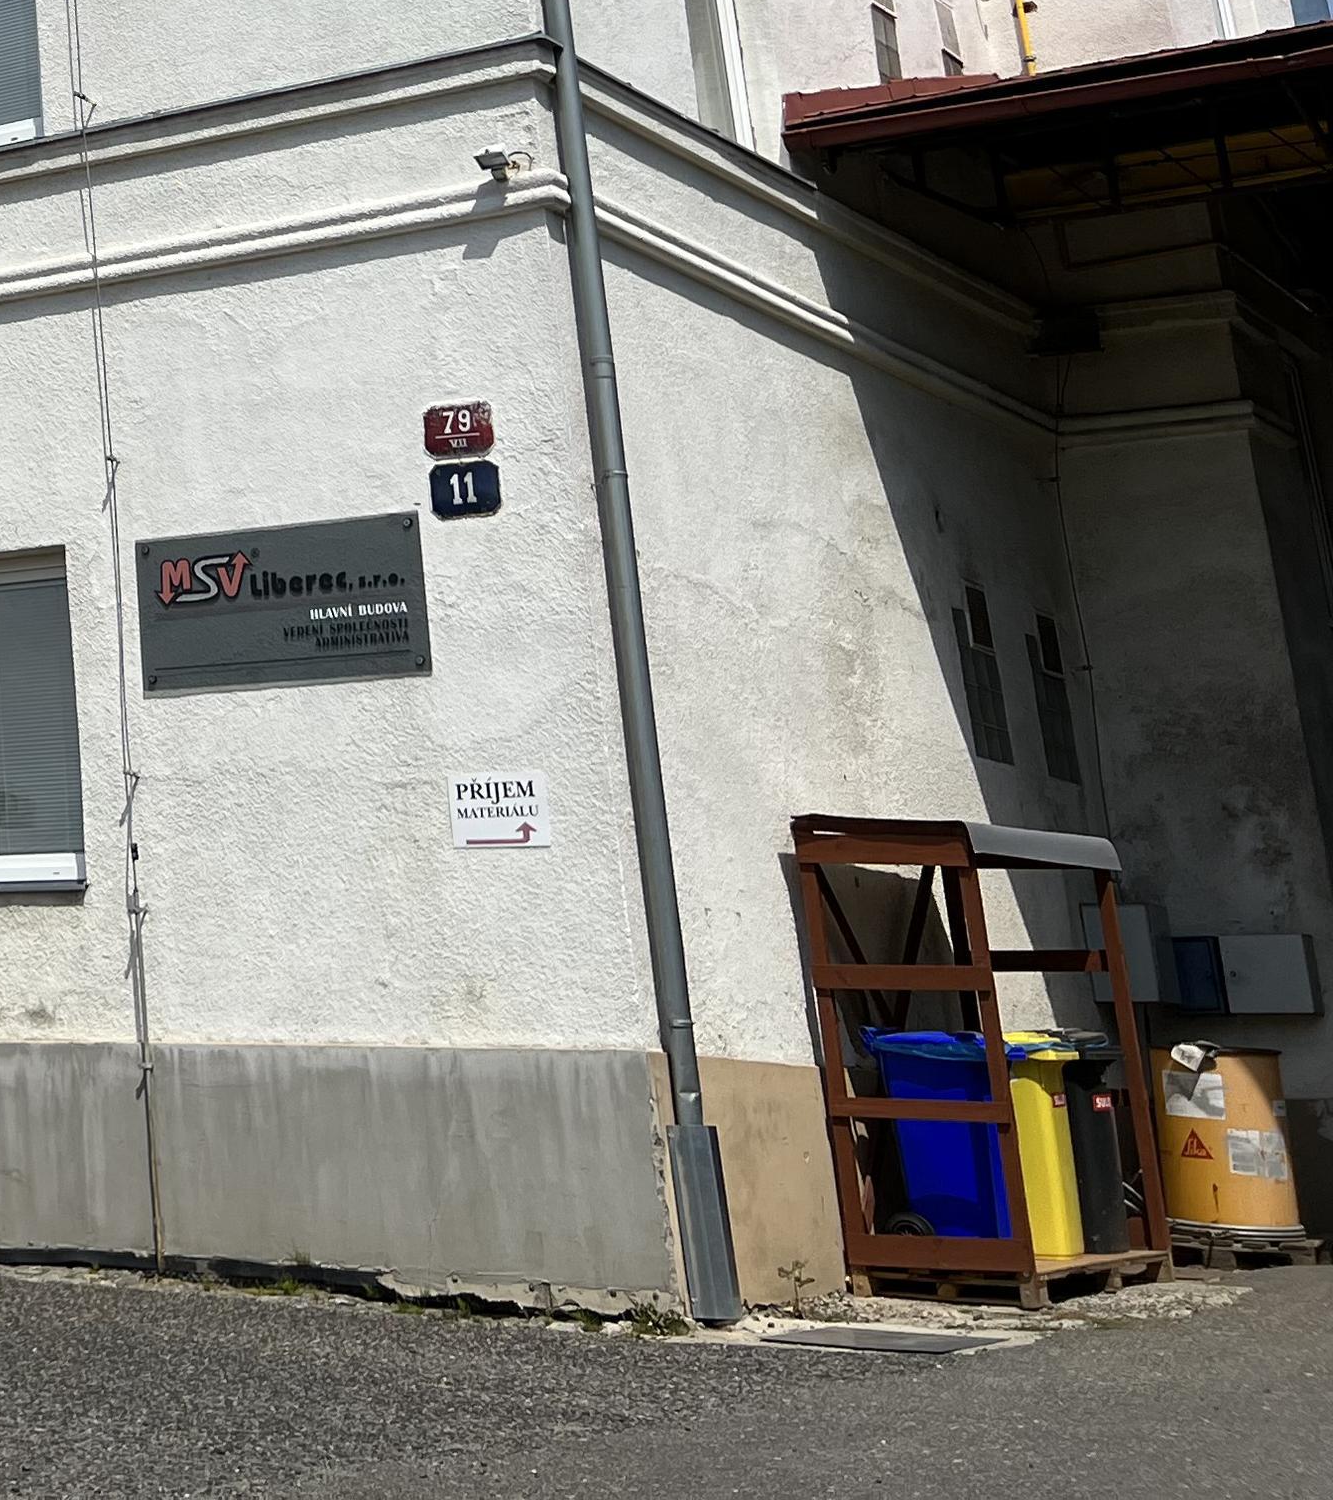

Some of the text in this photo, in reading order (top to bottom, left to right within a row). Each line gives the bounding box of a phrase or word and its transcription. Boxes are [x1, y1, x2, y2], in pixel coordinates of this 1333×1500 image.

[442, 409, 471, 434] 79
[448, 438, 468, 449] VII
[449, 471, 478, 506] 11
[155, 550, 405, 607] MSV Liberec, s.r.o.
[309, 601, 408, 620] HLAVNÍ BUDOVA
[283, 617, 408, 638] VEDENÍ SPOLEČNOSTI
[315, 630, 410, 648] ADMINISTRATIVA
[455, 776, 535, 804] PŘÍJEM
[457, 802, 539, 819] MATERIÁLU
